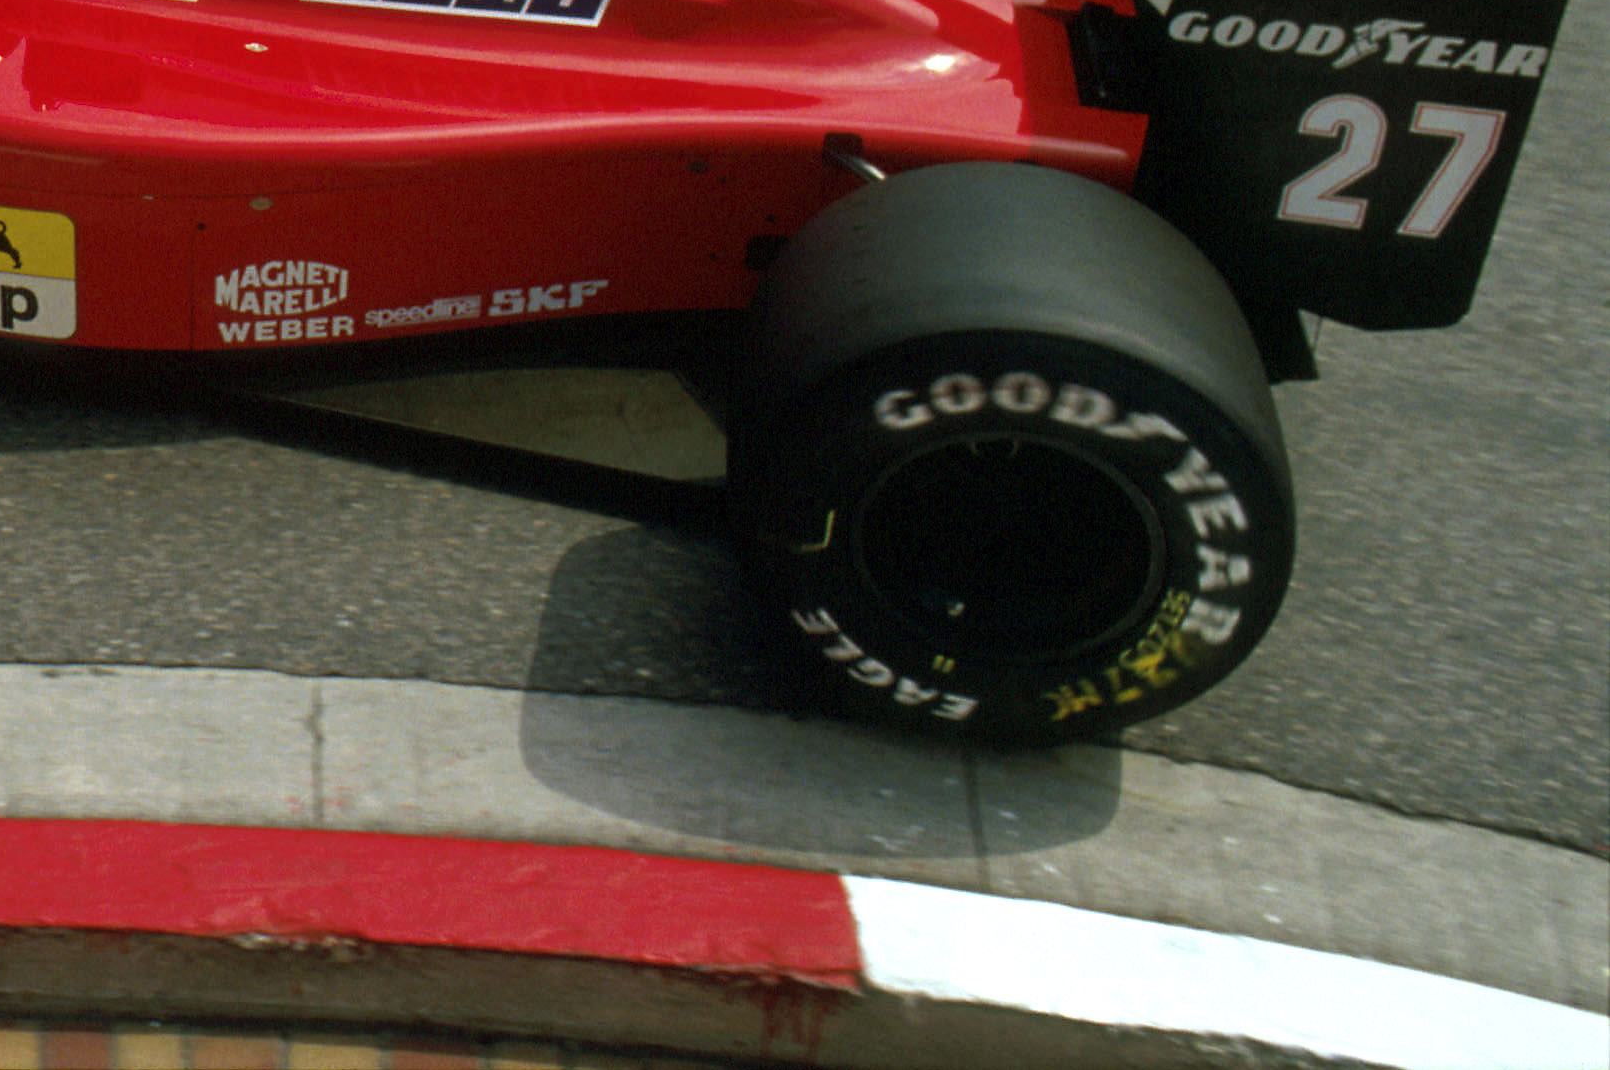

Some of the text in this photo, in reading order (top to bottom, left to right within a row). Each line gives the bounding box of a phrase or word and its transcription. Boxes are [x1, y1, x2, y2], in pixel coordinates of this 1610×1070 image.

[1167, 11, 1550, 79] GOODYEAR
[1277, 93, 1507, 240] 27
[214, 260, 349, 307] MAGNETI
[214, 266, 349, 316] MARELLI
[487, 279, 610, 317] SKF
[218, 315, 356, 344] WEBER
[364, 293, 482, 329] speedline
[872, 370, 1253, 645] GOODYEAR
[791, 606, 980, 722] EAGLE
